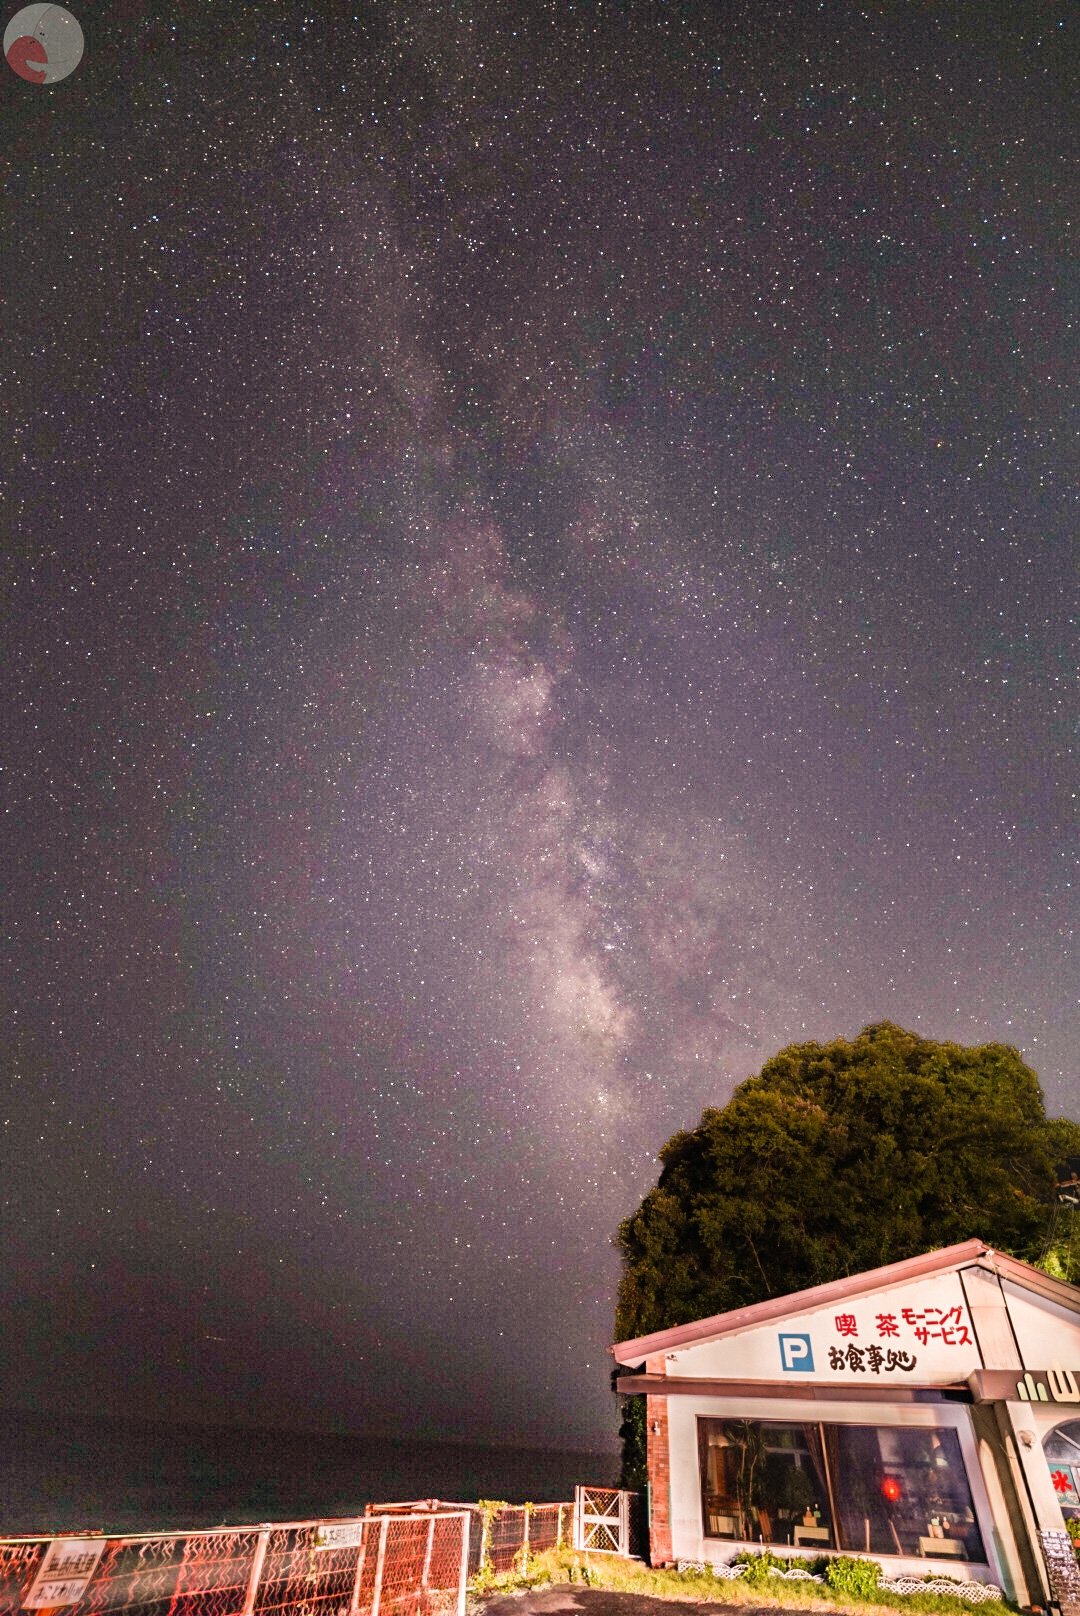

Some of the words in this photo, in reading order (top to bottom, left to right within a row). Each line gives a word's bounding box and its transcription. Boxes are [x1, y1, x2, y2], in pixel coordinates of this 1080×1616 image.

[901, 1305, 964, 1326] モーニング
[914, 1326, 974, 1346] サービス
[783, 1338, 808, 1368] P
[828, 1343, 917, 1374] お食事処
